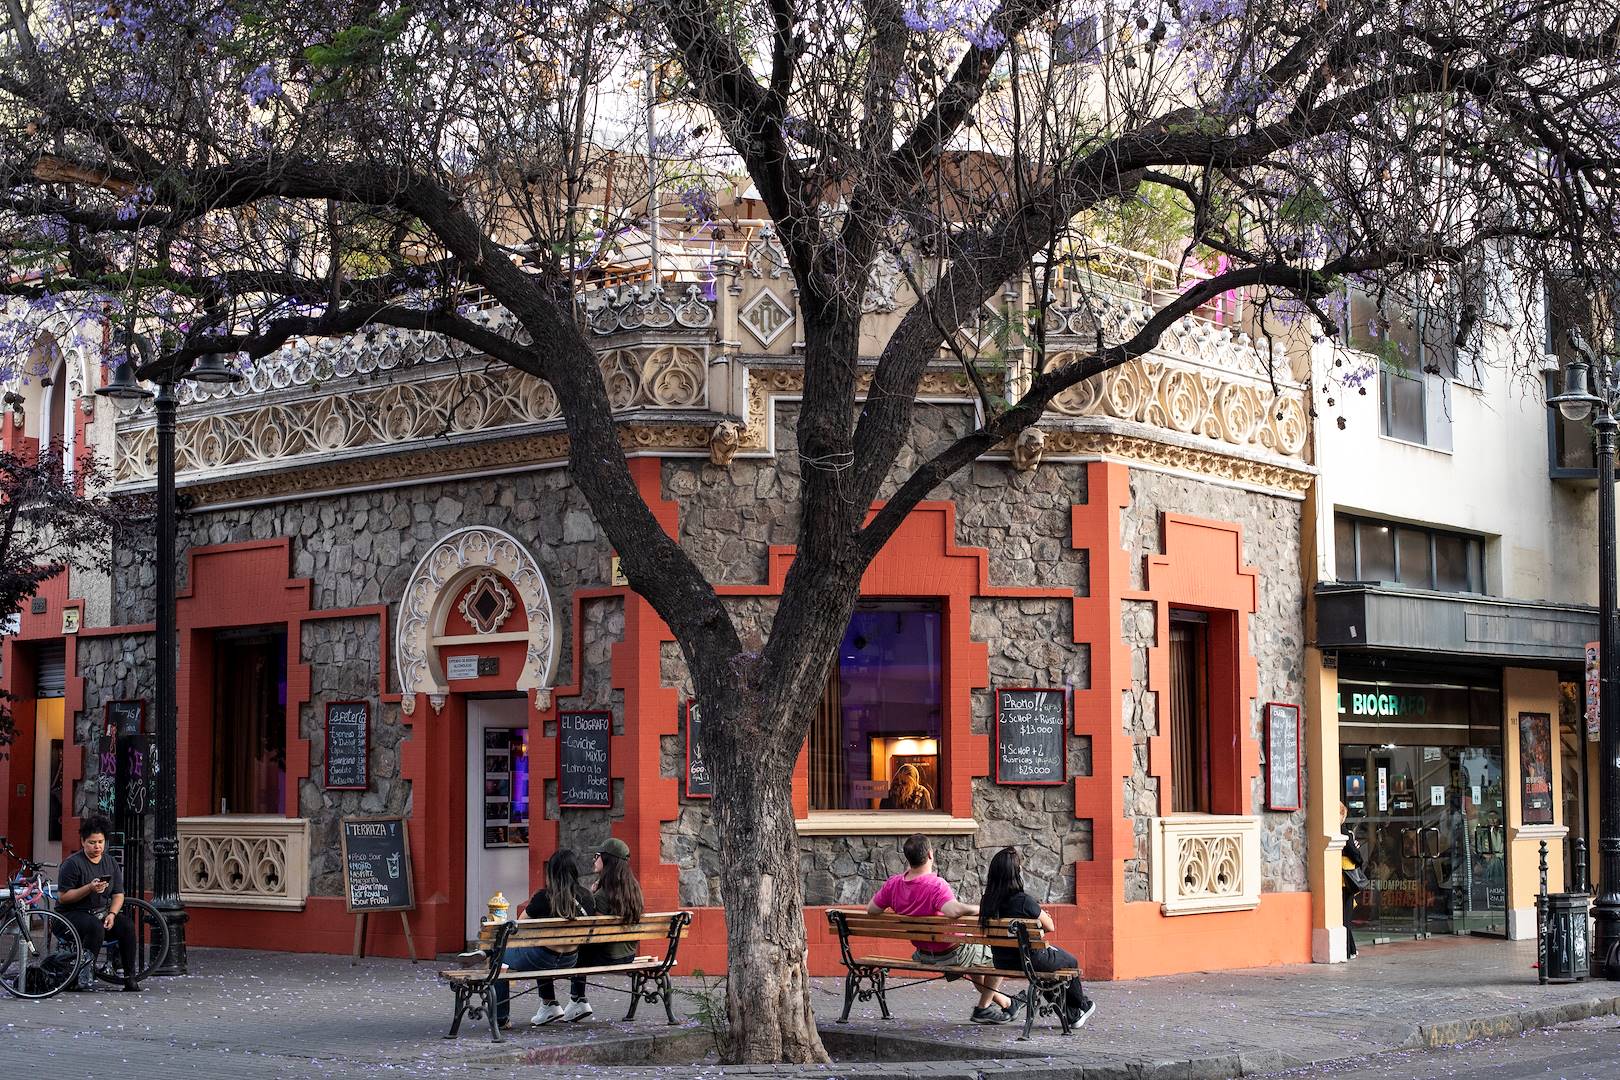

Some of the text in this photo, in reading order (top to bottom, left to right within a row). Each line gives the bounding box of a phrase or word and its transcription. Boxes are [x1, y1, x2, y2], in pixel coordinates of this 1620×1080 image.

[1337, 693, 1426, 716] L BIOGRAFO
[562, 716, 572, 729] EL
[1000, 713, 1007, 724] 2
